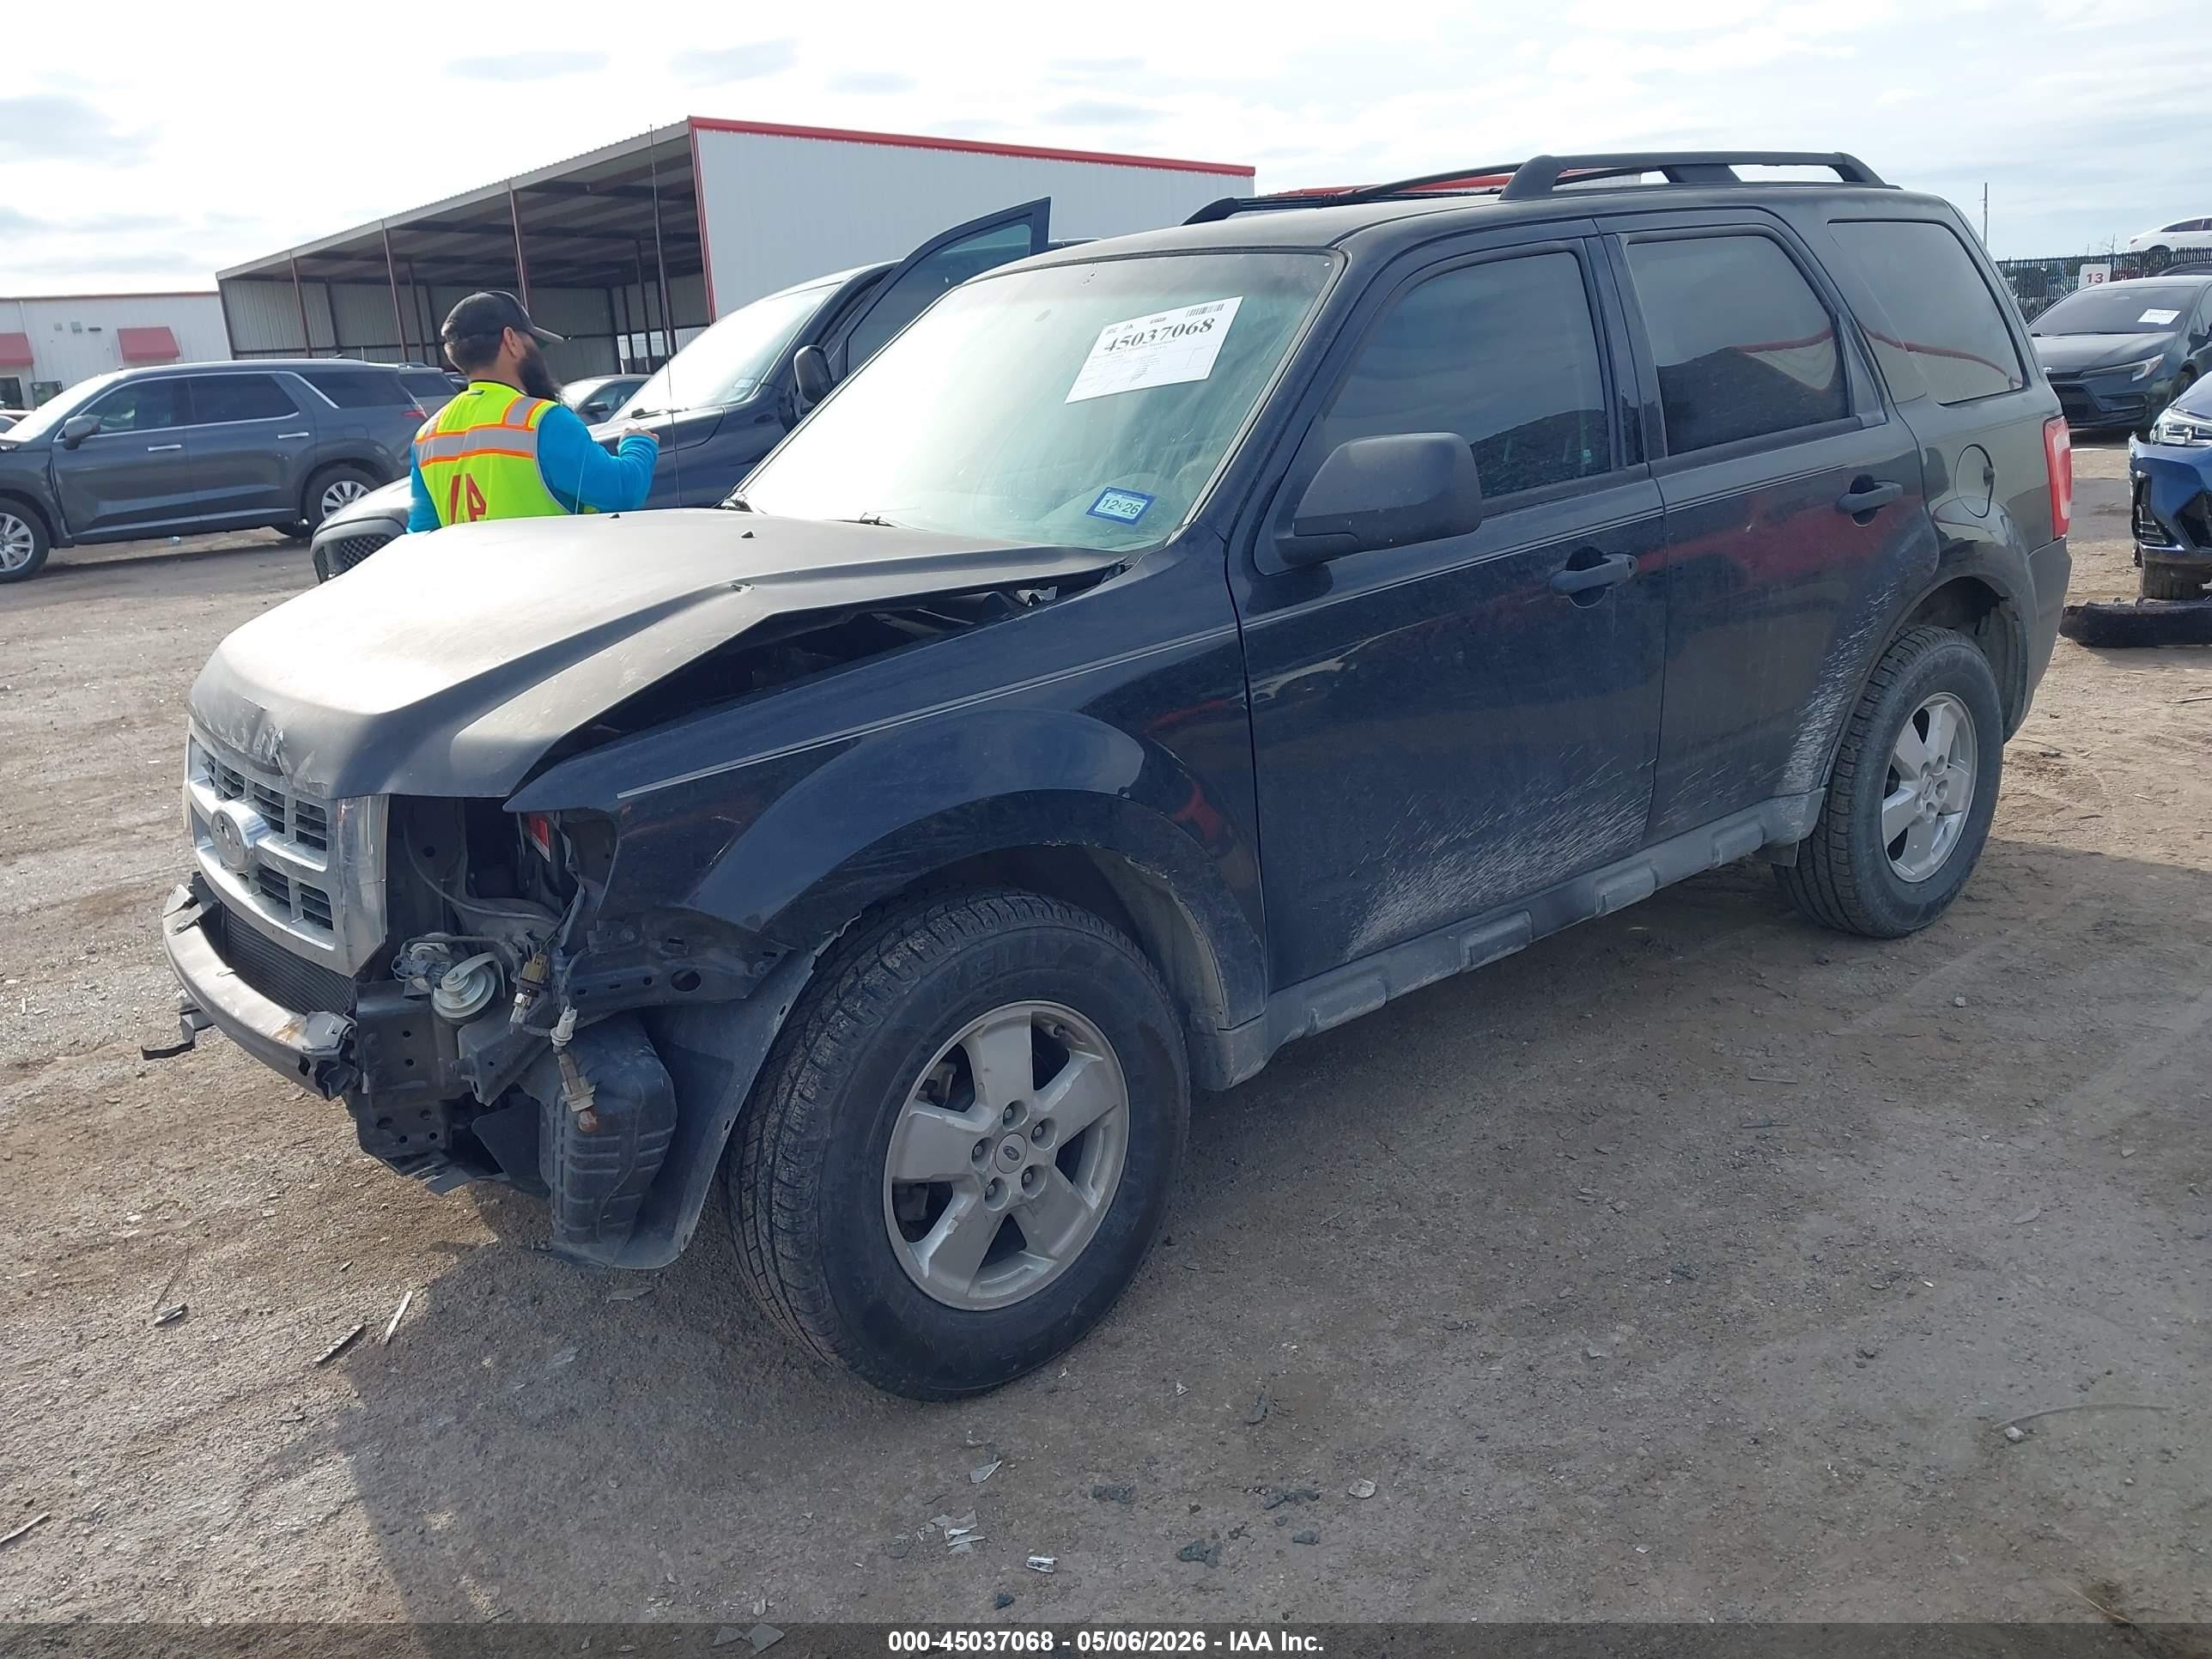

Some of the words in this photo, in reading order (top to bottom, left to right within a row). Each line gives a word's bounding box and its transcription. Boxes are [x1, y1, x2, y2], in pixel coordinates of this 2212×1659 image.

[2087, 273, 2104, 283] 13
[1103, 318, 1216, 352] 45037068
[1102, 498, 1120, 510] 12
[1121, 502, 1141, 515] 26
